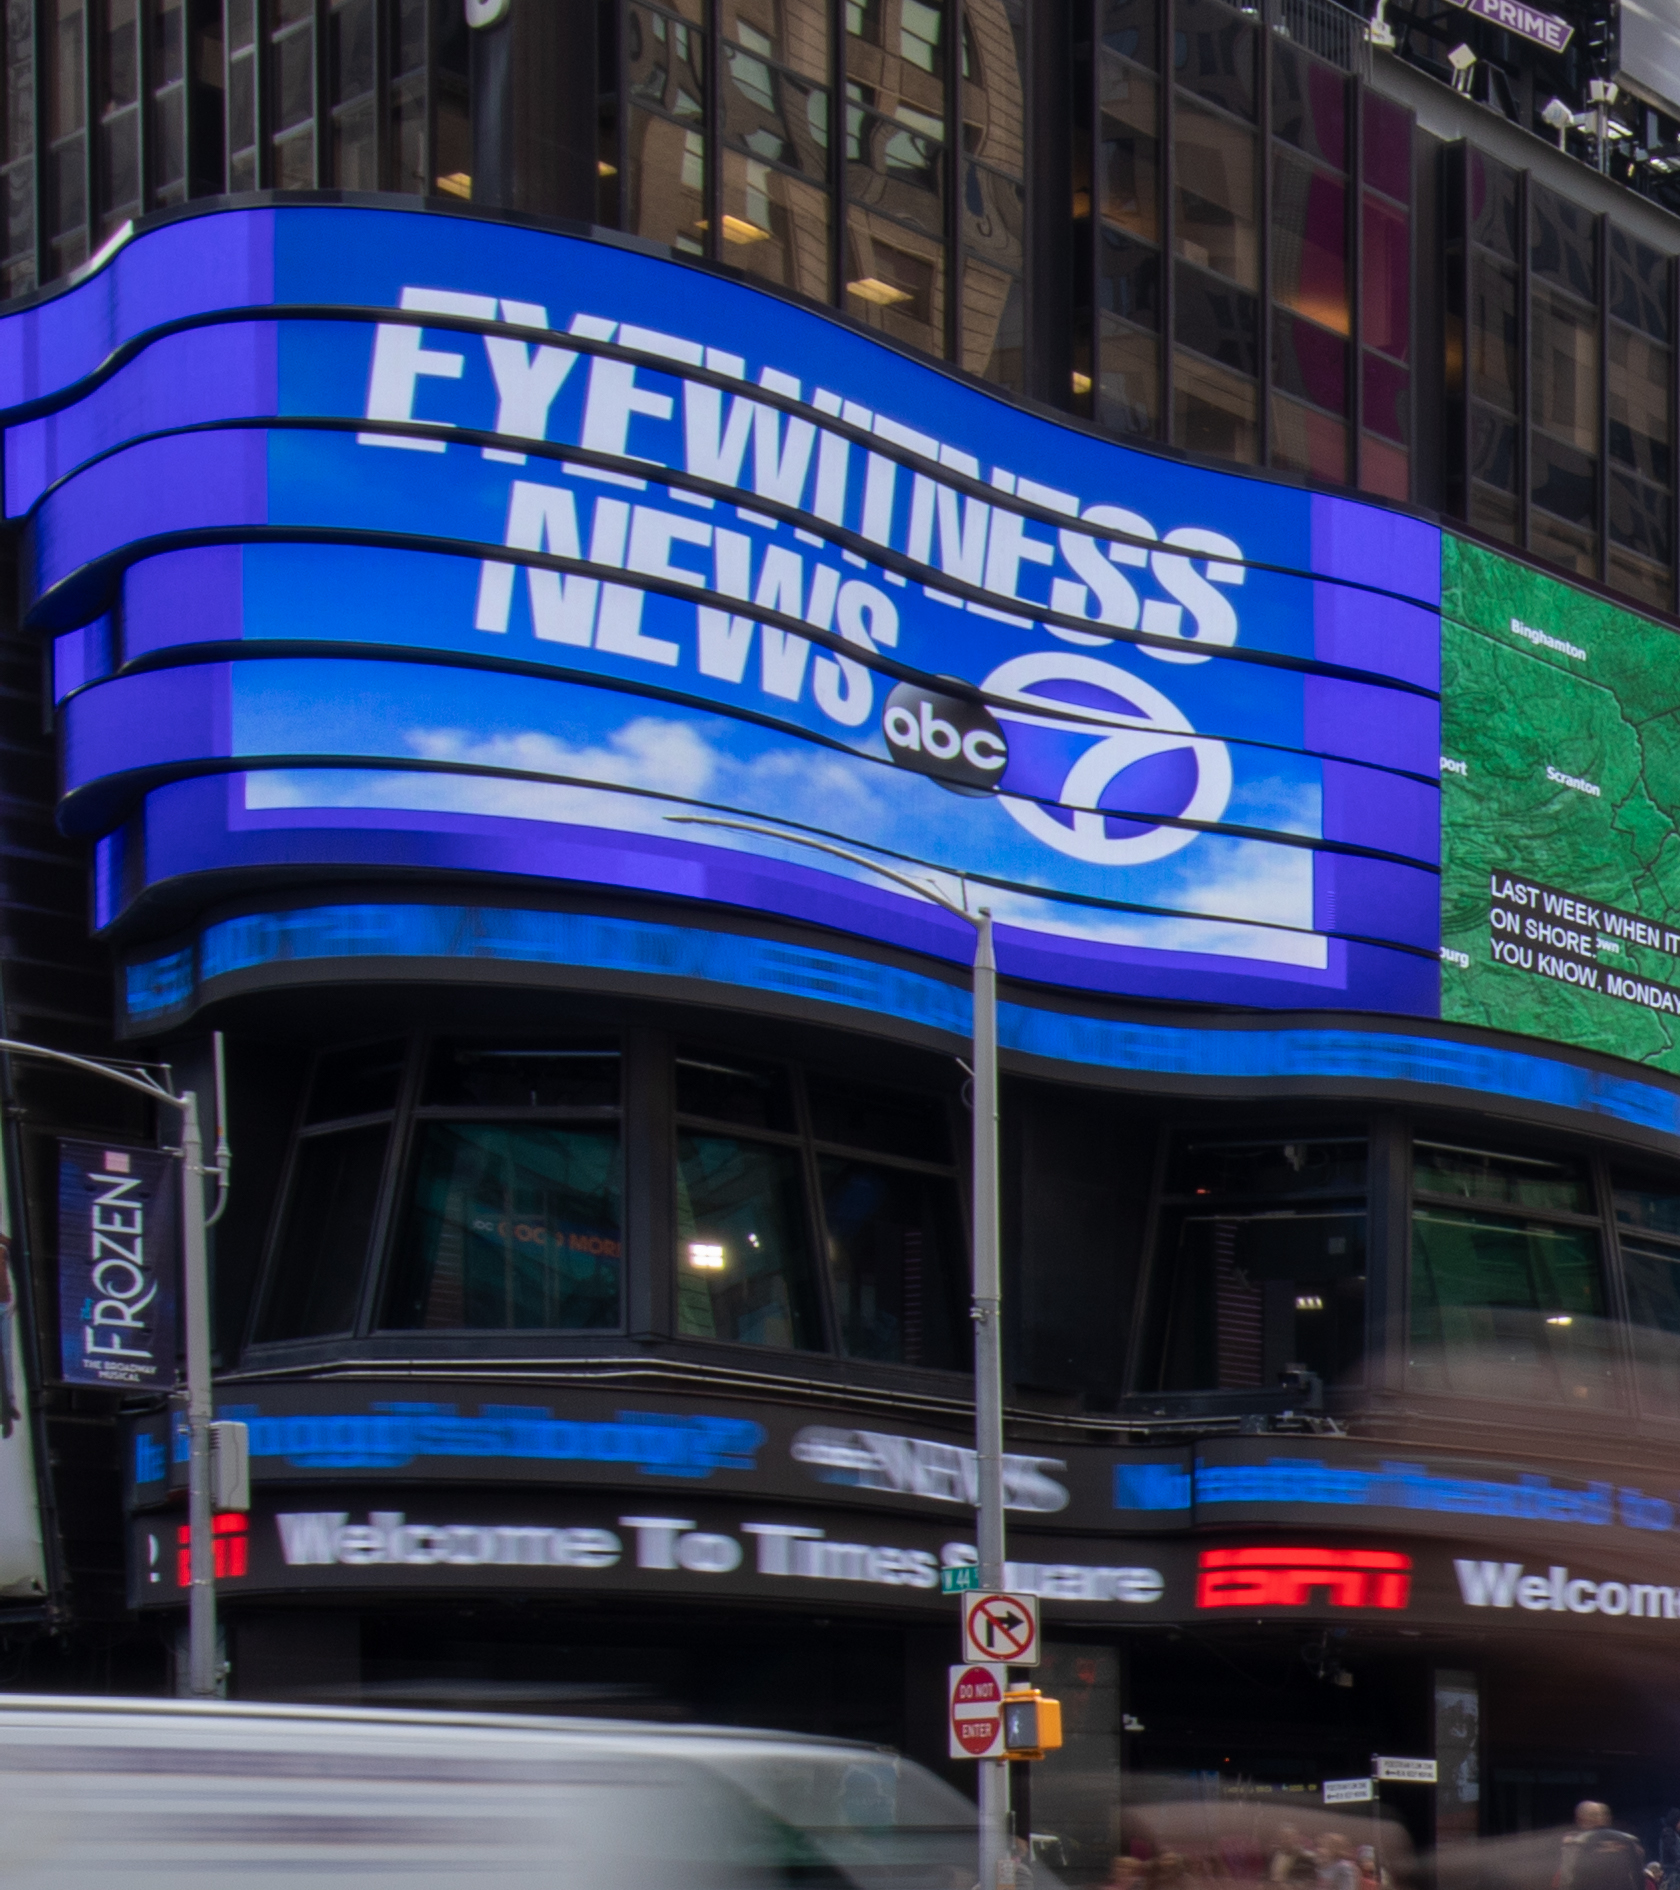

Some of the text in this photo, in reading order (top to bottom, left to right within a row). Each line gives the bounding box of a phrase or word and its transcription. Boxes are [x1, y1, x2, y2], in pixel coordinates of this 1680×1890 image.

[357, 286, 1244, 664] EYEWITNESS
[476, 483, 901, 726] NEWS
[1510, 617, 1587, 661] Binghamton
[884, 701, 1009, 778] abc
[1440, 756, 1468, 776] port
[1546, 766, 1601, 797] Scranton
[1490, 908, 1597, 959] ON SHORE.
[1491, 875, 1540, 909] LAST
[1543, 892, 1601, 930] WEEK
[1603, 911, 1660, 949] WHEN
[1490, 937, 1532, 968] YOU
[1538, 952, 1603, 992] KNOW,
[84, 1172, 158, 1358] FROZEN
[275, 1511, 622, 1568] Welcome
[740, 1523, 938, 1588] Times
[960, 1683, 994, 1698] DO NOT
[961, 1723, 993, 1738] ENTER
